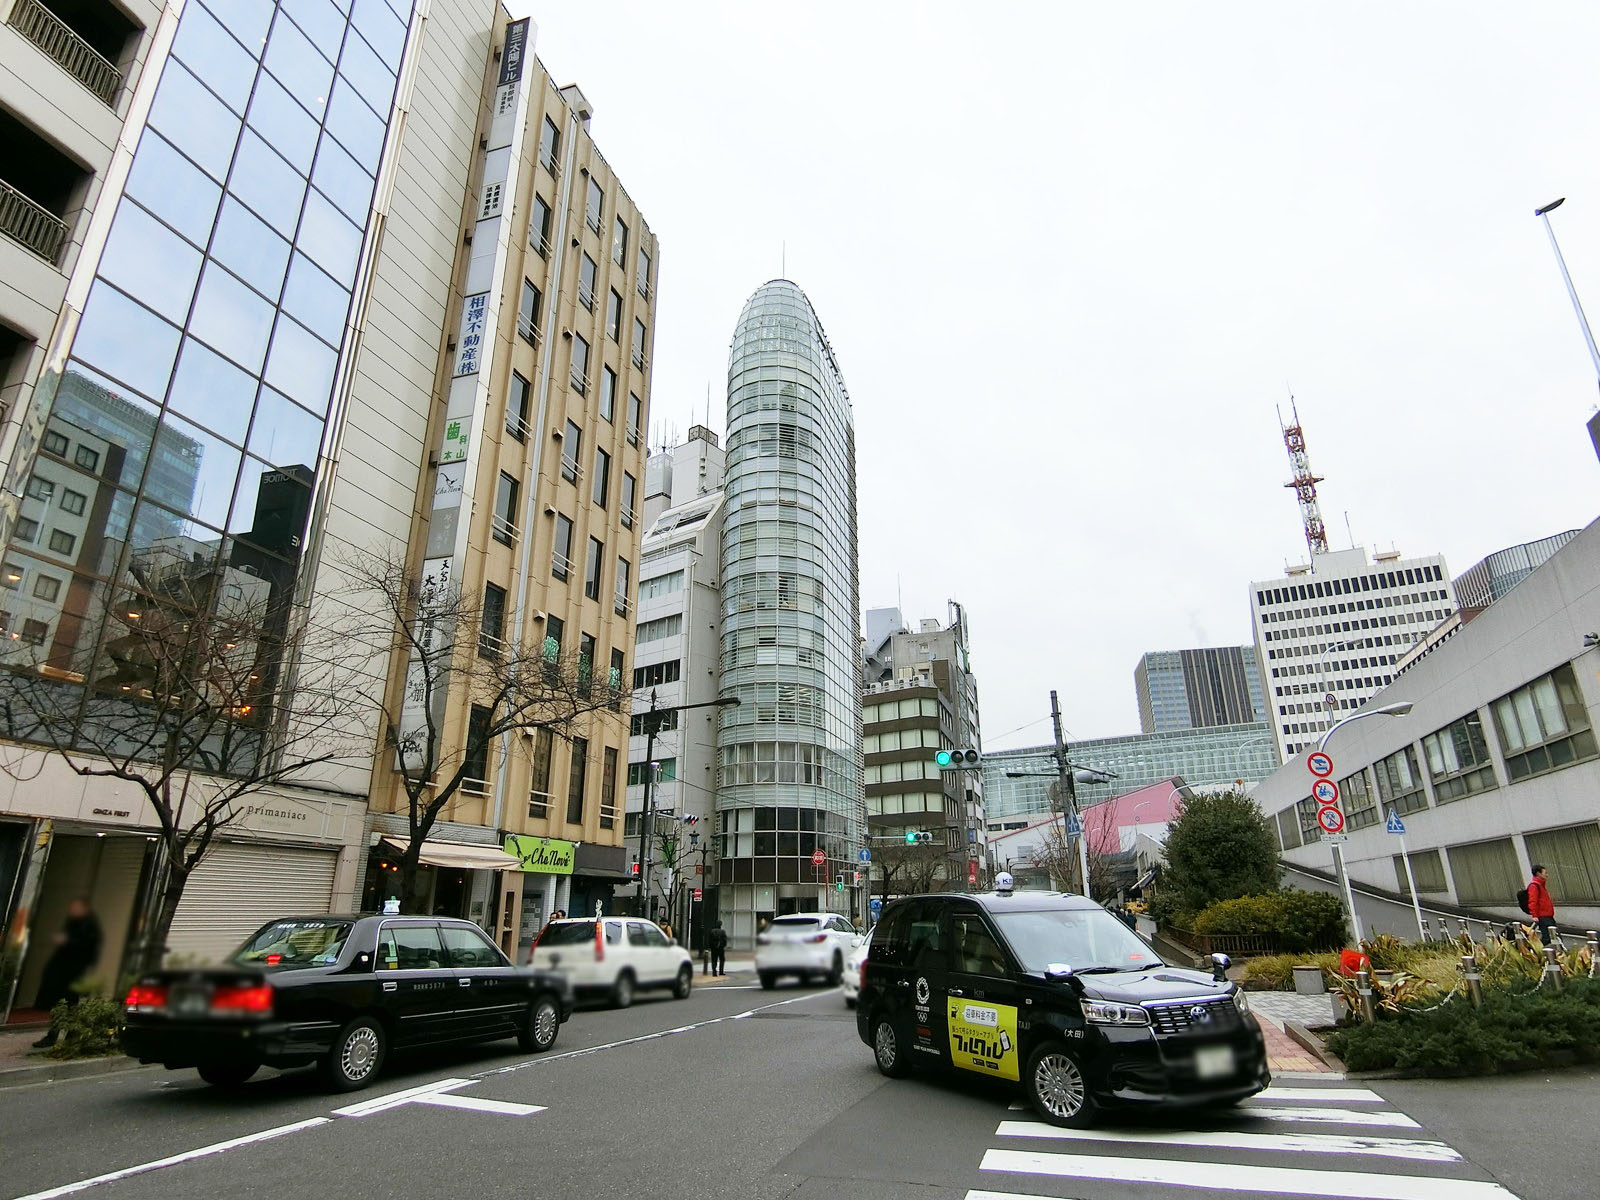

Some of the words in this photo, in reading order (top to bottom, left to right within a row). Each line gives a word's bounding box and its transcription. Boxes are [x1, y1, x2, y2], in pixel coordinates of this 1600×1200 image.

[443, 448, 465, 460] 本山
[93, 808, 112, 816] GINZA
[247, 805, 307, 821] primaniacs
